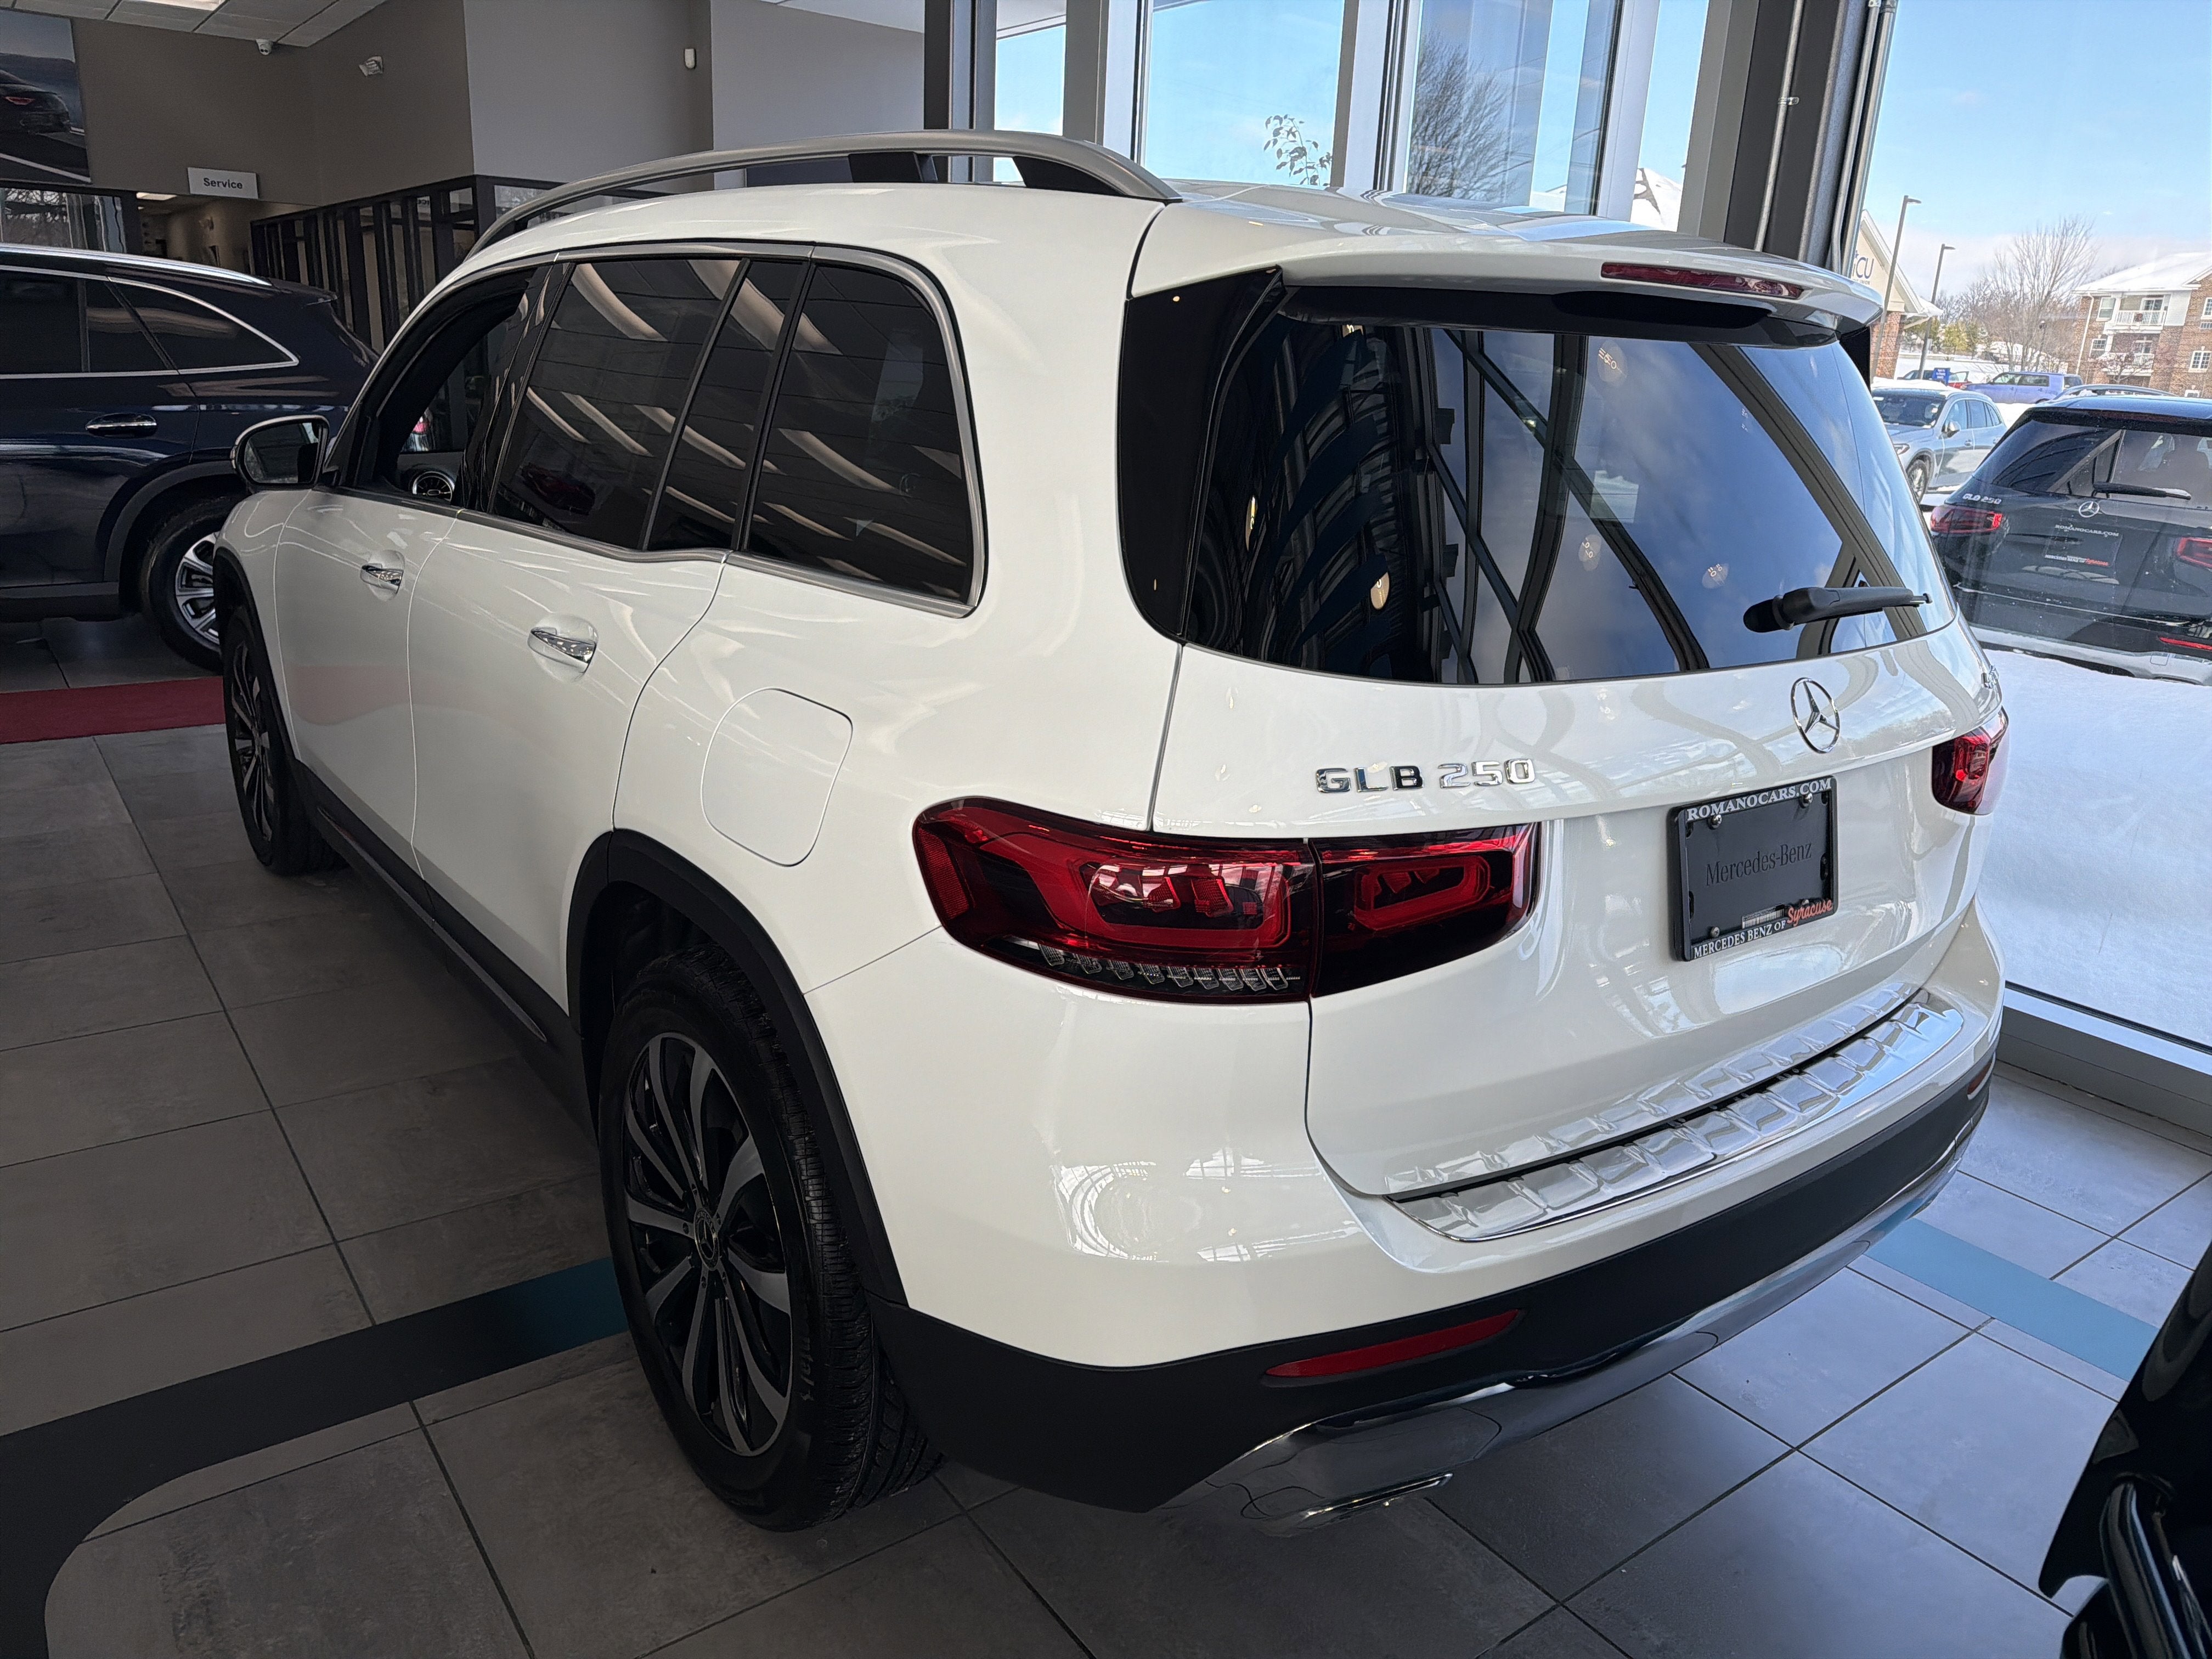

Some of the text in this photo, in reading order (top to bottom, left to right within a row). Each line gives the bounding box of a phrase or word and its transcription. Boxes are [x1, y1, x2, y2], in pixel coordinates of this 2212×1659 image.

[203, 177, 243, 189] Service
[1316, 758, 1536, 793] GLB 250
[1686, 777, 1832, 822] ROMANOCARS.COM
[1706, 842, 1813, 887] Mercedes-Benz
[1693, 931, 1746, 959] MERCEDES
[1747, 923, 1773, 941] BENZ
[1774, 919, 1787, 935] OF
[1787, 899, 1833, 928] Syracuse
